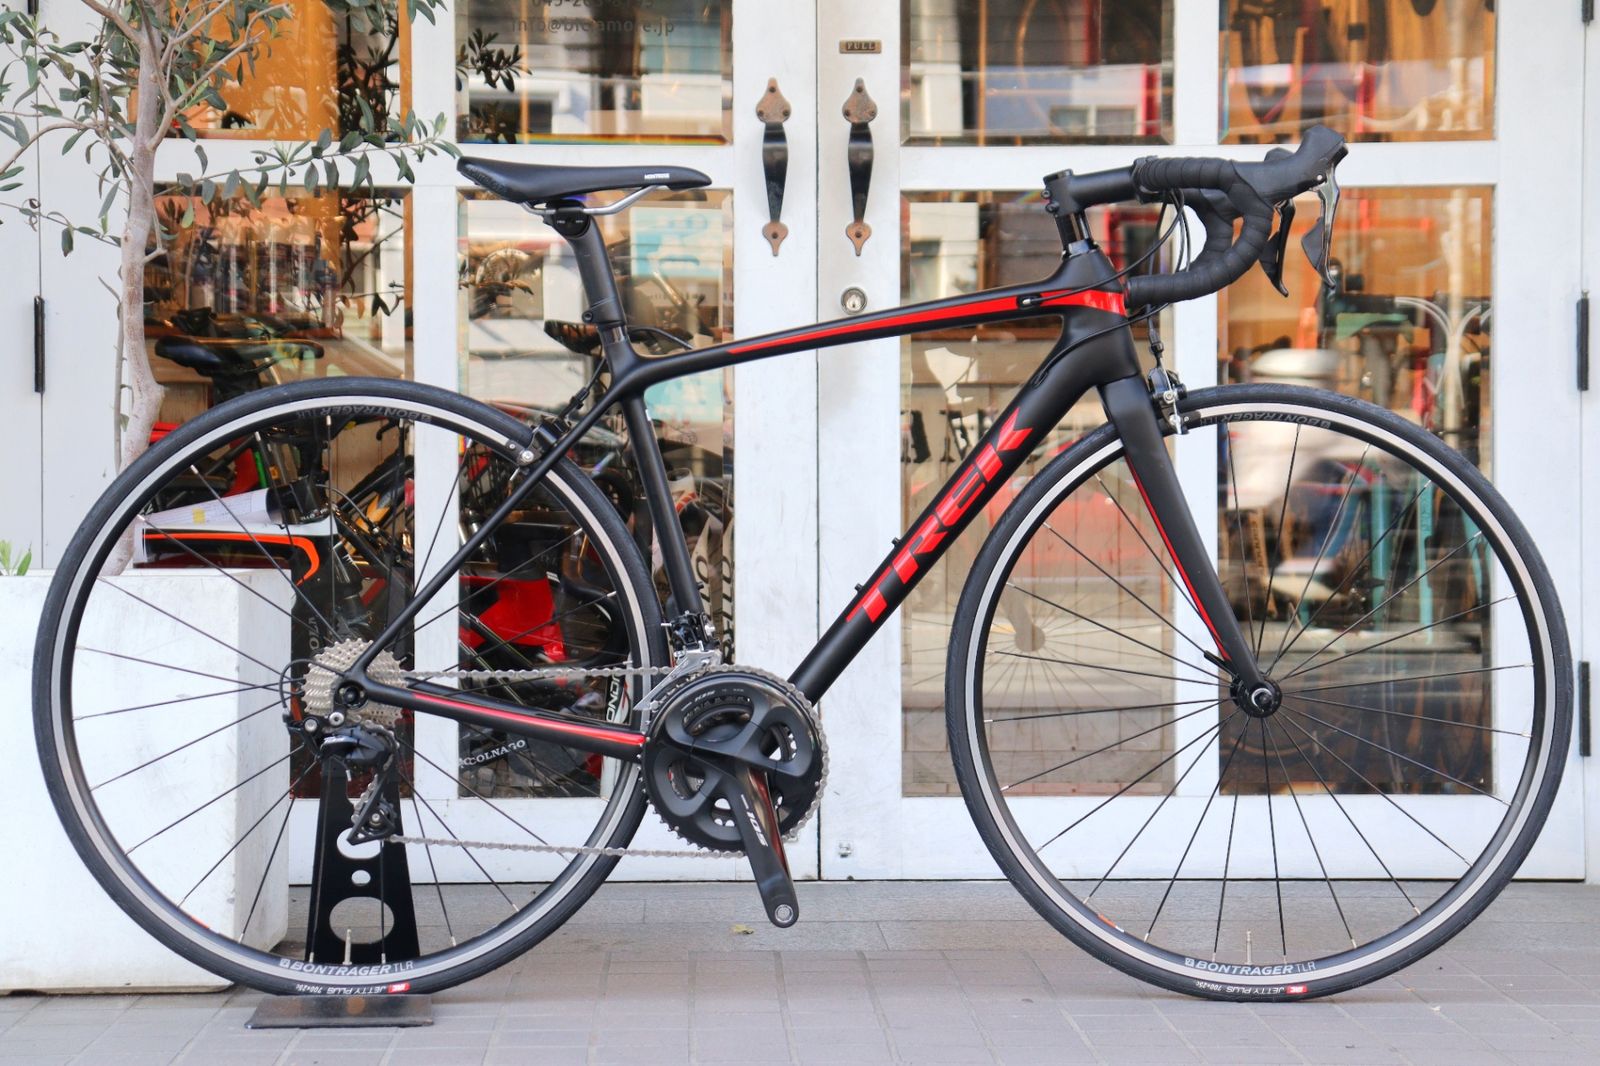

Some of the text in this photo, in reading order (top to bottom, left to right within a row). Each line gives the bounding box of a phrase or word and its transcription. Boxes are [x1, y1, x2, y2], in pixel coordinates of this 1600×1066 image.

[847, 41, 875, 50] PULL
[320, 405, 423, 421] BONTRAGER
[1221, 412, 1320, 427] BONTRAGER
[846, 407, 1033, 624] TREK
[290, 961, 415, 976] BONTRAGER TLR
[1195, 960, 1317, 976] BONTRAGER TLR
[327, 986, 353, 995] PLUS
[354, 986, 386, 995] JETTY
[1226, 986, 1252, 994] PLUS
[1252, 986, 1285, 995] JETTY
